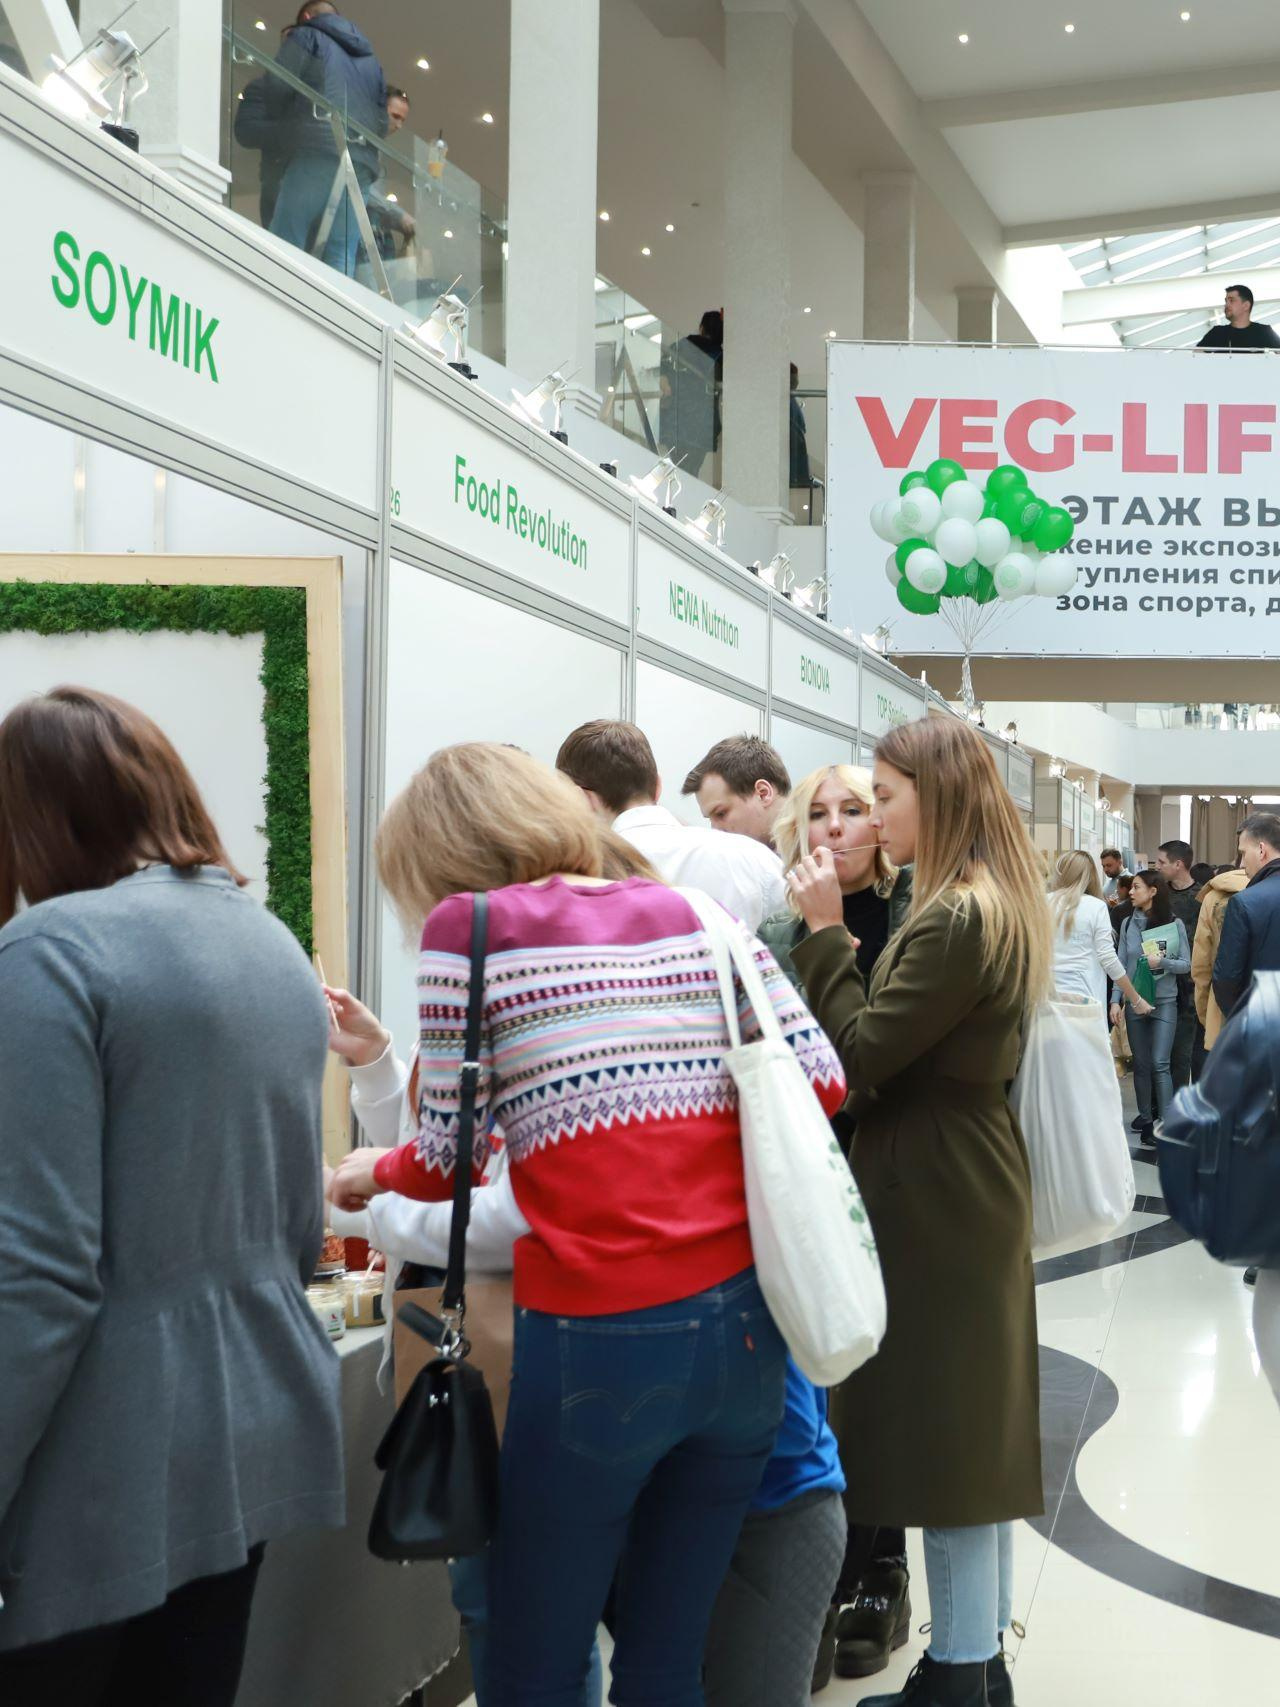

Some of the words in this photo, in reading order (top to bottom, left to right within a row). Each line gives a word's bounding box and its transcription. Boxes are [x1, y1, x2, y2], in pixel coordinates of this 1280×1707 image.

[51, 230, 220, 384] SOYMIK
[454, 454, 501, 525] Food
[506, 484, 588, 570] Revolution
[1060, 495, 1202, 526] ЭТАЖ
[669, 580, 701, 632] NEWA
[701, 600, 740, 650] Nutrition
[1056, 594, 1128, 611] зона
[1138, 595, 1256, 618] спорта,
[800, 655, 830, 694] BIONOVA
